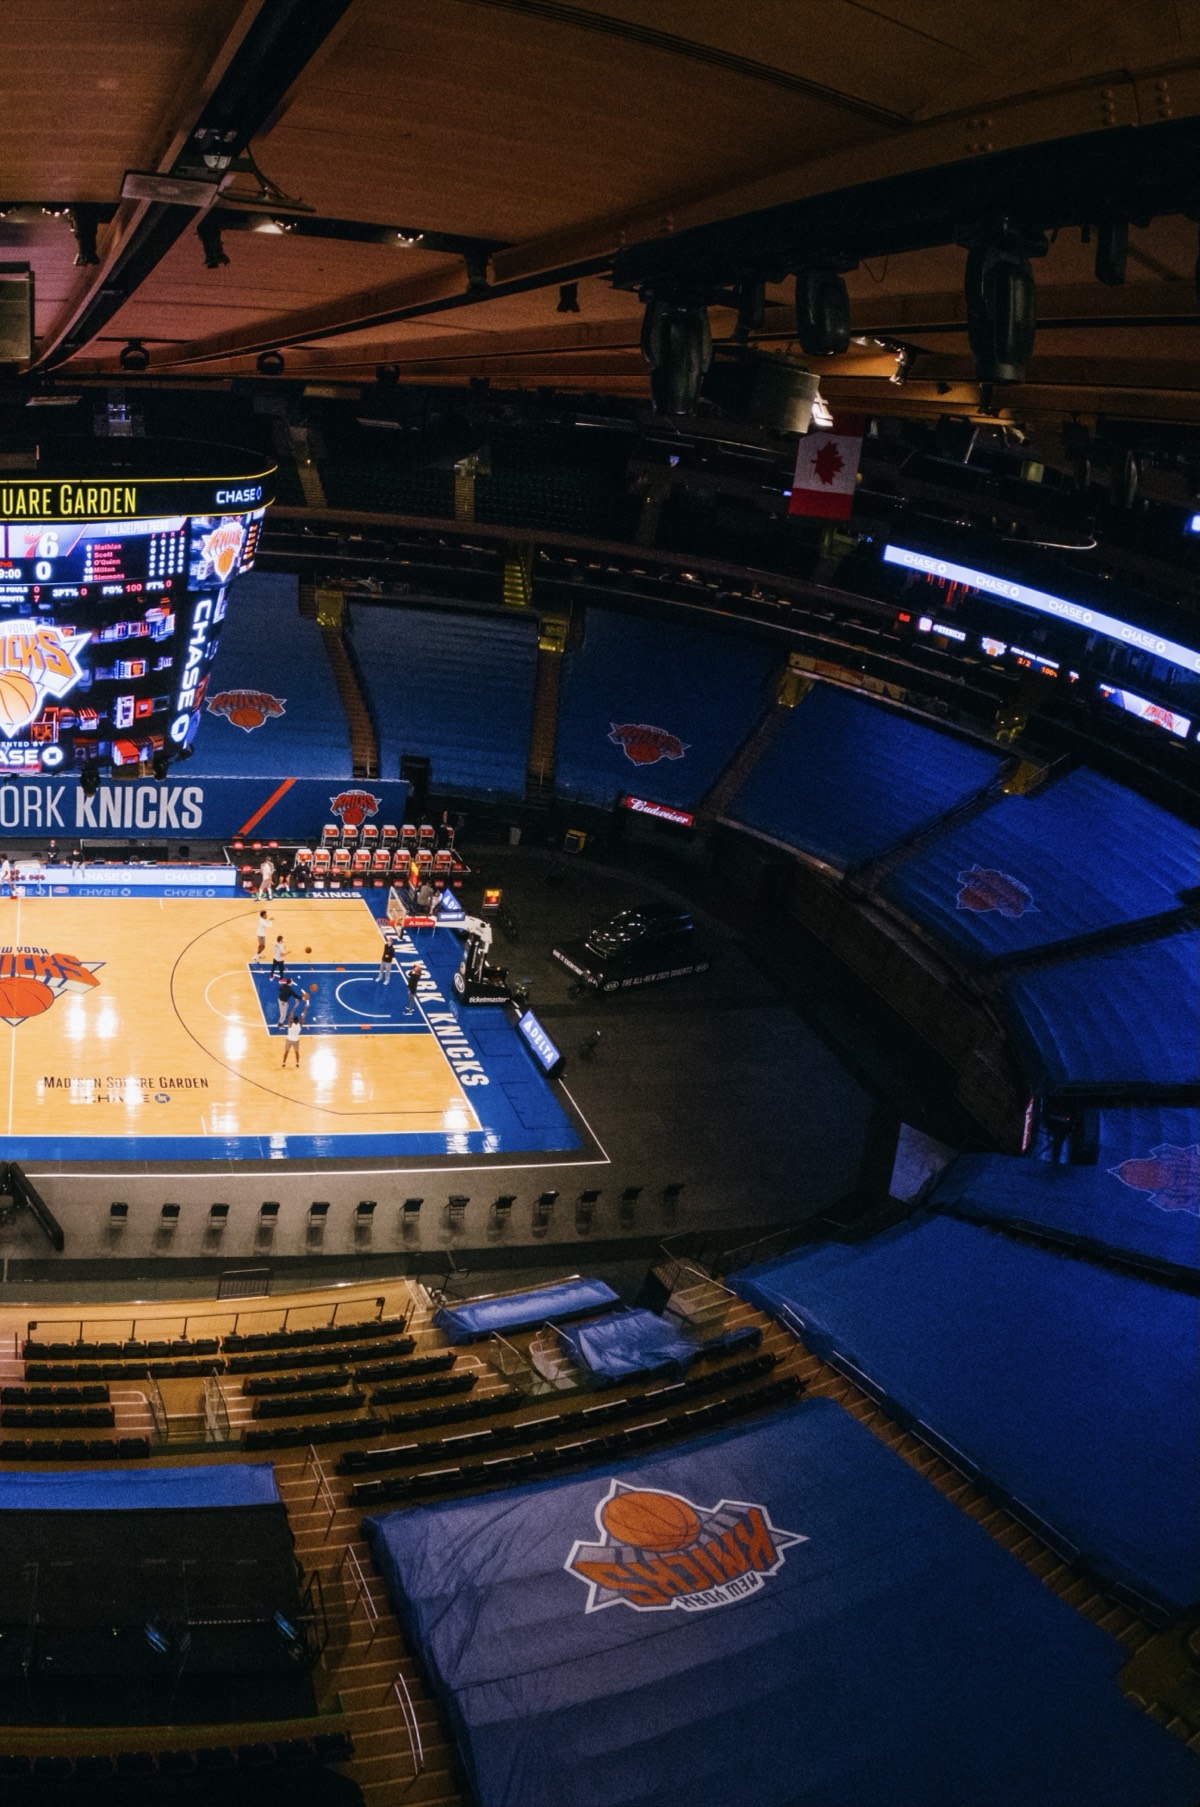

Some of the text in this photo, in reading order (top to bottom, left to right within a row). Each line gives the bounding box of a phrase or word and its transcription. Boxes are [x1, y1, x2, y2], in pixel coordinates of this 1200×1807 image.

[59, 485, 137, 514] GARDEN
[216, 487, 256, 505] CHASE
[93, 543, 121, 551] Mathias
[35, 561, 51, 580] 0
[903, 554, 938, 572] CHASE
[93, 573, 125, 581] Simmons
[976, 575, 1011, 596] CHASE
[52, 588, 78, 597] 3PT%
[102, 585, 123, 594] FG%
[125, 583, 142, 593] 100
[146, 581, 165, 591] FT%
[166, 580, 172, 588] 0
[34, 595, 40, 603] 7
[1048, 599, 1083, 621] CHASE
[1121, 627, 1156, 650] CHASE
[177, 599, 213, 712] CHASE
[1017, 657, 1031, 667] 2/2
[75, 786, 204, 829] KNICKS
[630, 798, 689, 824] Budweiser
[79, 872, 120, 882] CHASE
[164, 872, 205, 882] CHASE
[16, 947, 51, 955] YORK
[426, 1012, 490, 1086] KNICKS
[529, 1028, 555, 1063] DELTA
[159, 1076, 209, 1089] GARDEN
[573, 1507, 775, 1605] KNICKS
[682, 1572, 758, 1609] NEW YORK
